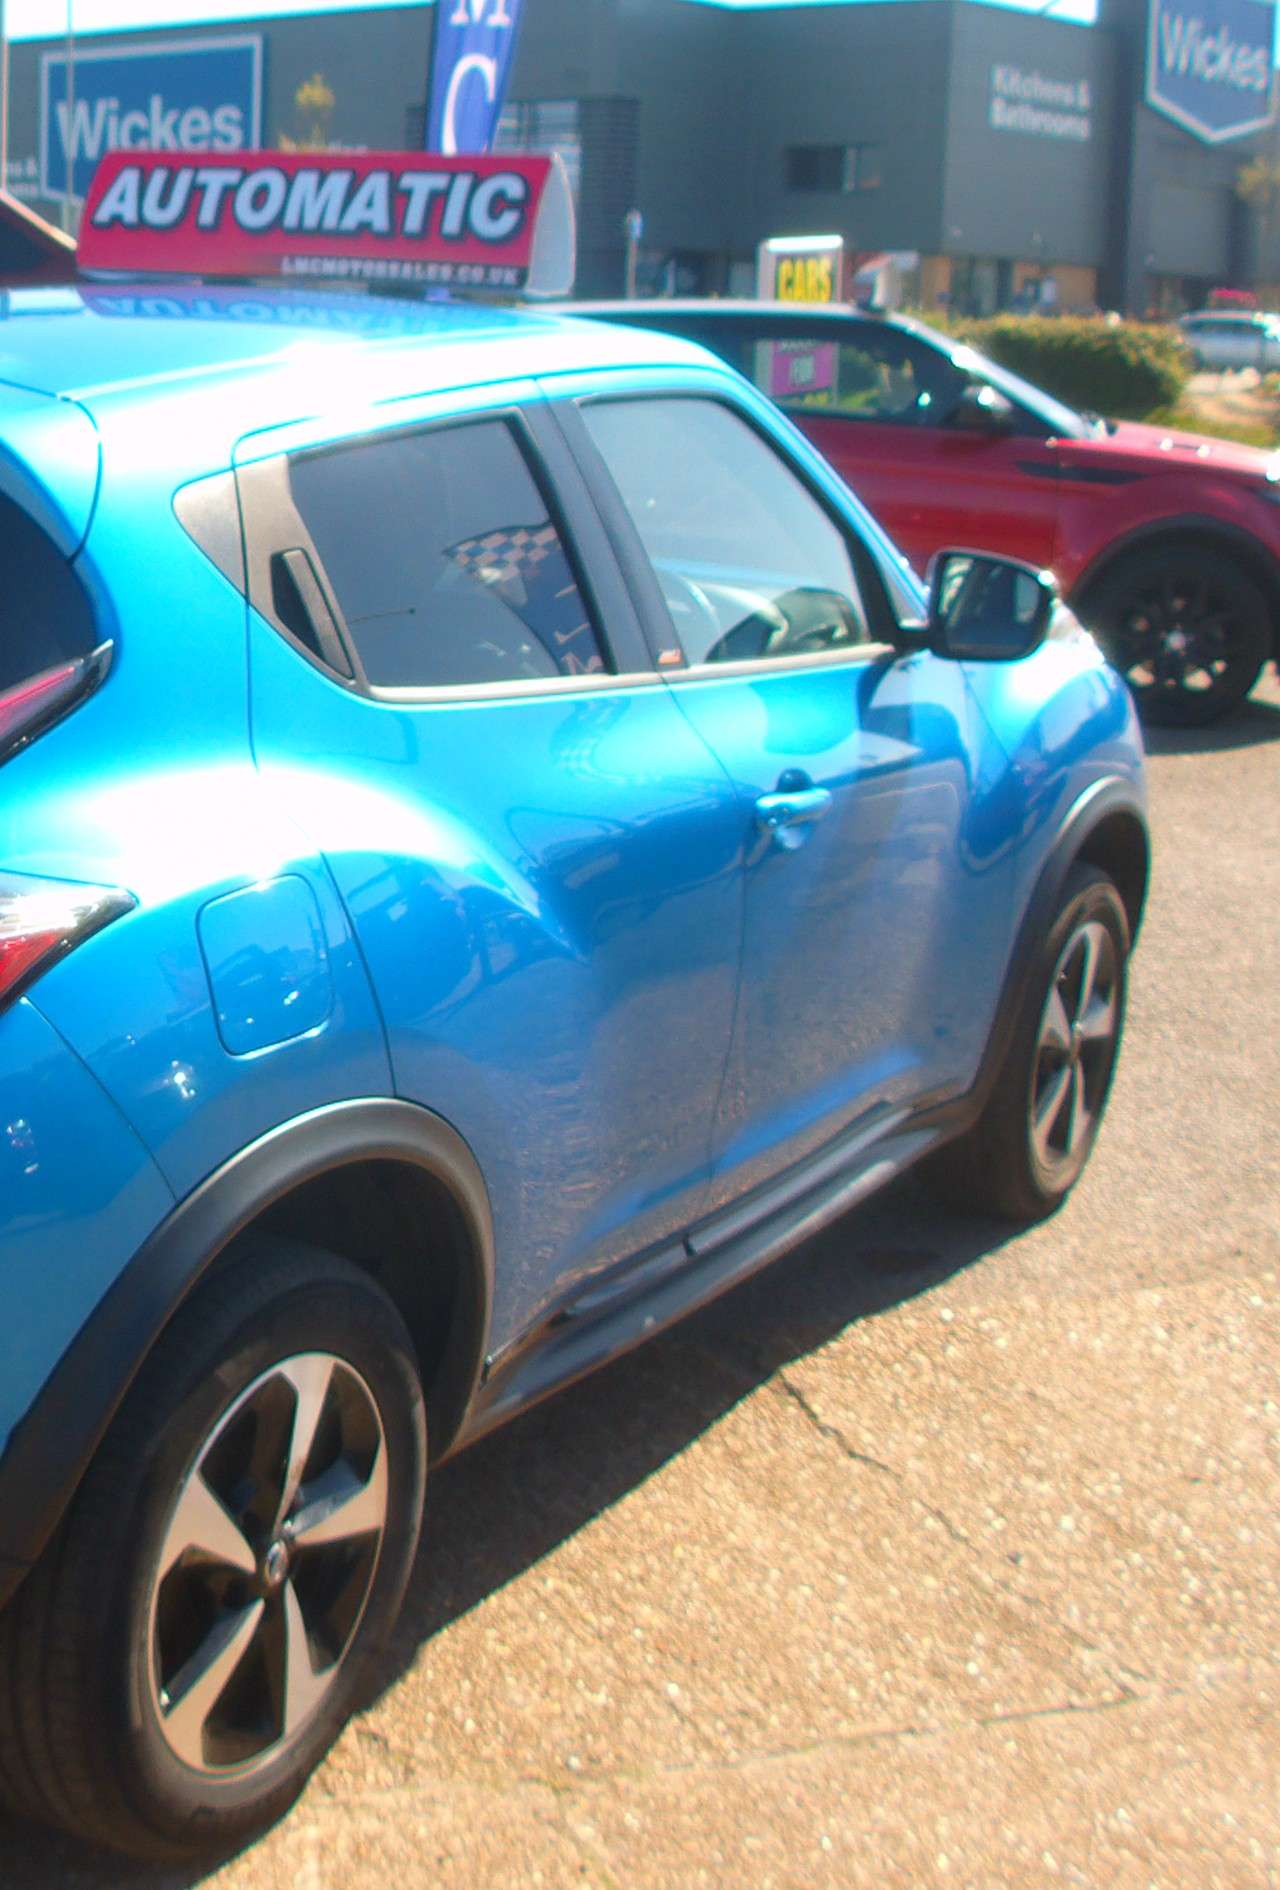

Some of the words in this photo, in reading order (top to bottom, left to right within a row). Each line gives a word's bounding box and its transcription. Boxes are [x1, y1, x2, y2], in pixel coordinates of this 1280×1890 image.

[1162, 14, 1268, 91] Wickes
[56, 94, 244, 161] Wickes
[93, 166, 528, 241] AUTOMATIC
[778, 256, 832, 304] CARS
